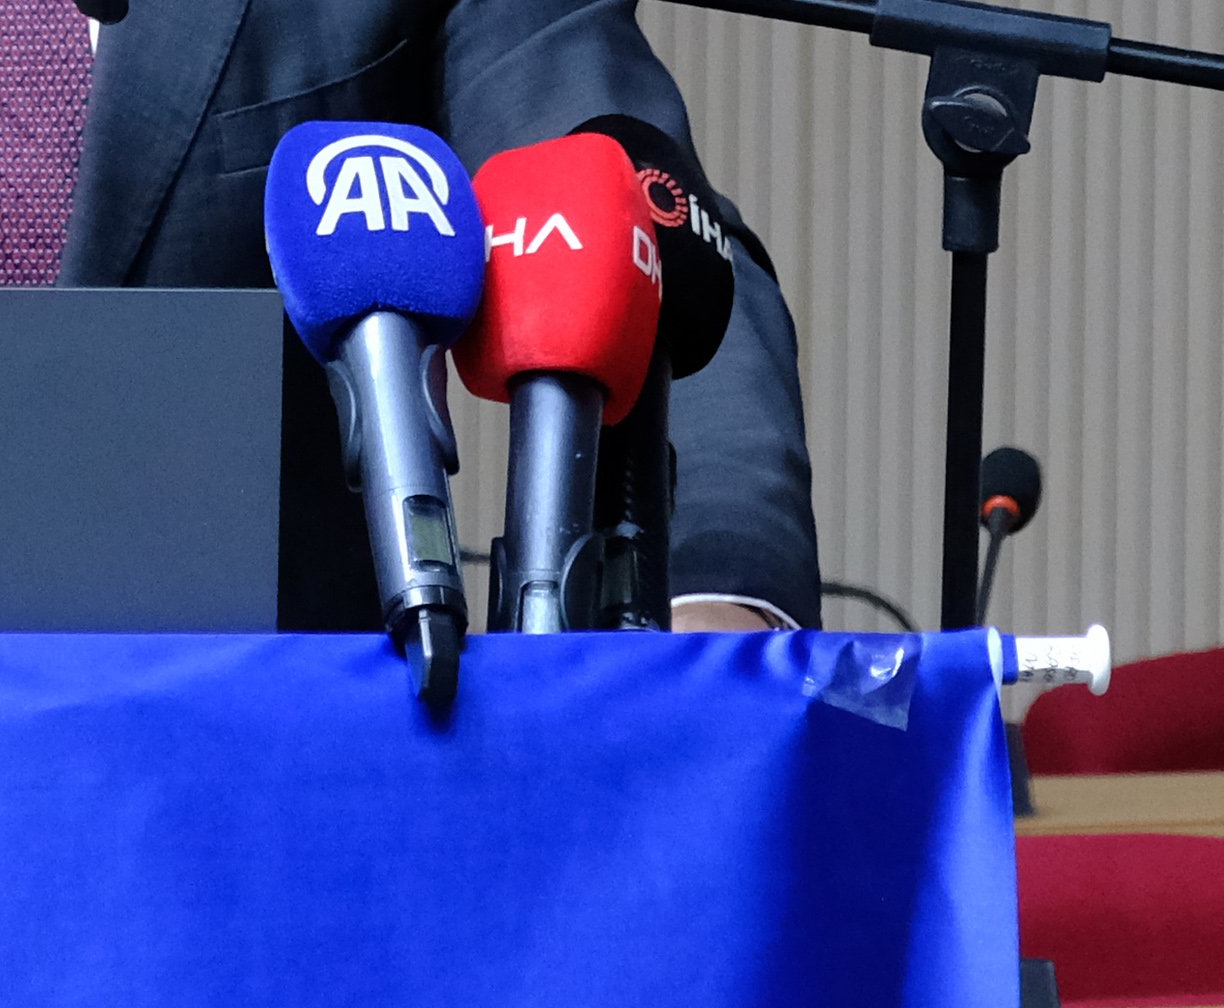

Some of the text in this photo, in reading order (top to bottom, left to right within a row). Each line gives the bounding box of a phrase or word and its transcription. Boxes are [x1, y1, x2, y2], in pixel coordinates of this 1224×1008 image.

[315, 155, 456, 237] AA
[484, 212, 584, 262] HA
[632, 224, 663, 303] DH
